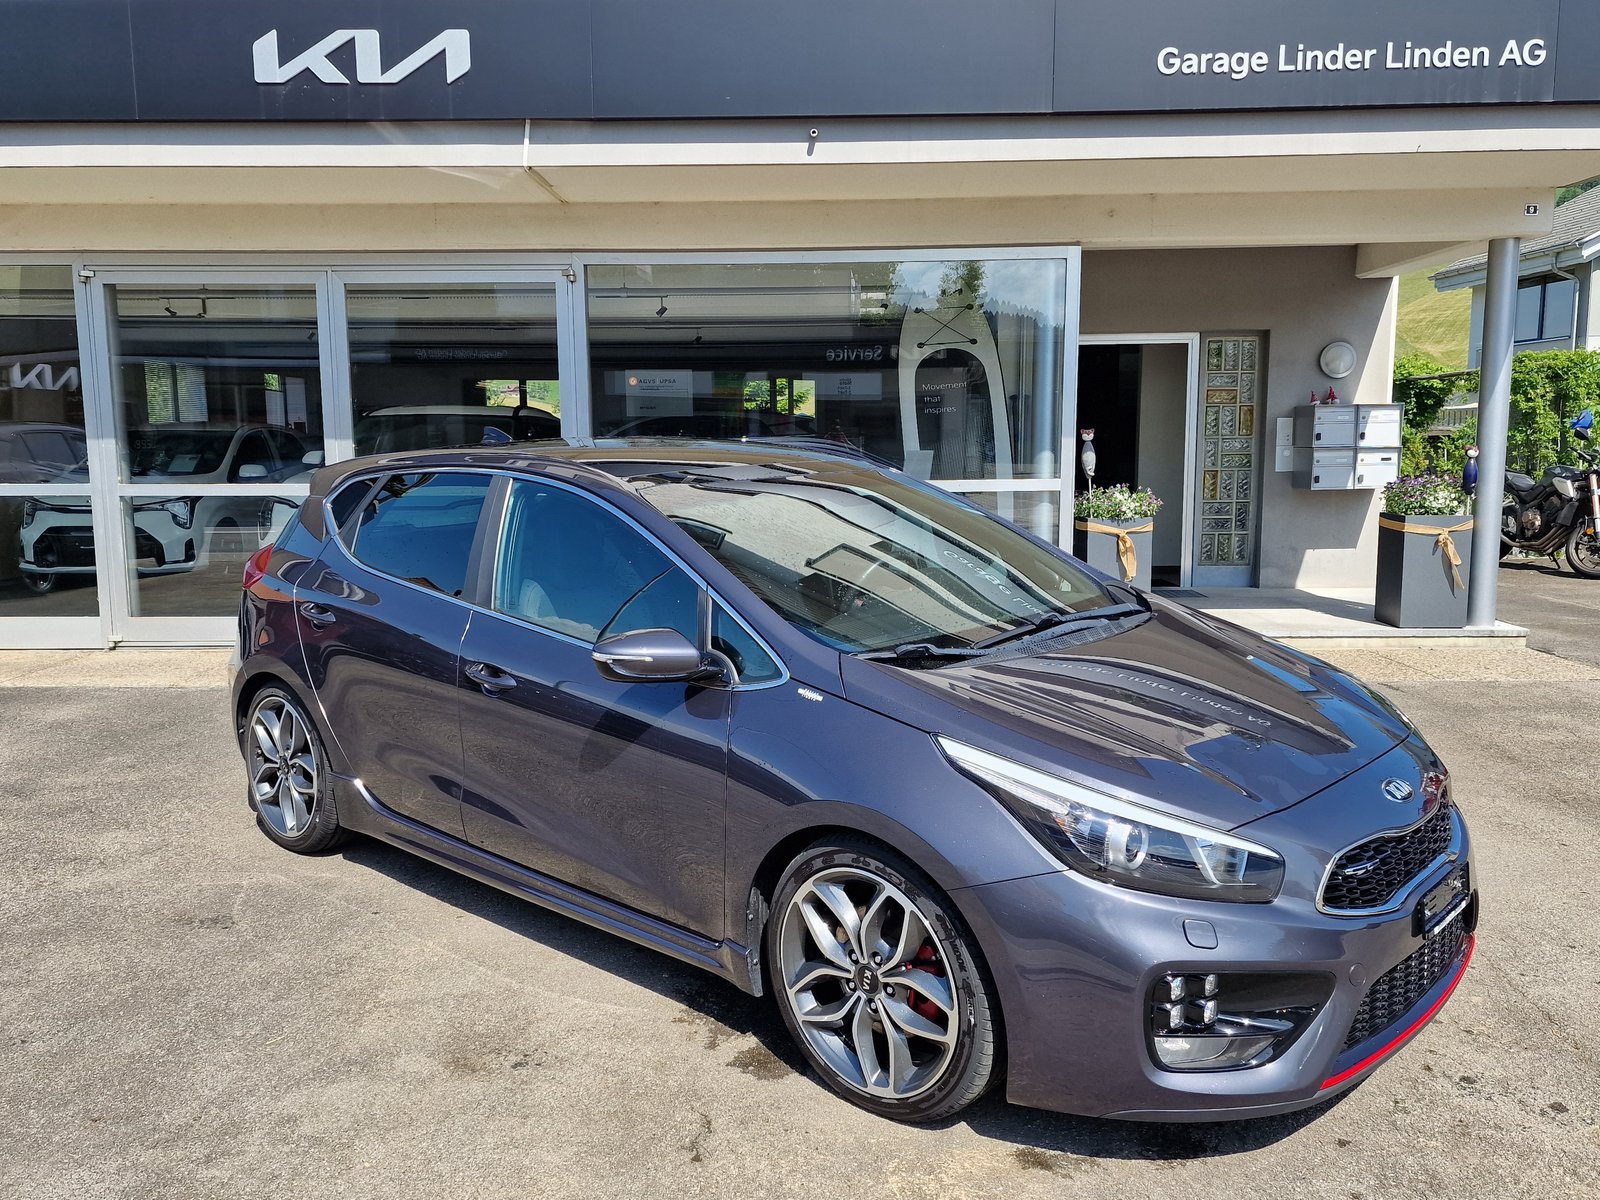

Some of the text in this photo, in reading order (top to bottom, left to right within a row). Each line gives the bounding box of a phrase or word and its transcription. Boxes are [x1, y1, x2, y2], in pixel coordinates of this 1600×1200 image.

[252, 29, 471, 84] KIA
[1156, 38, 1547, 80] Garage Linder Linden AG
[922, 381, 967, 391] Movement
[924, 395, 941, 403] that
[924, 406, 957, 415] inspires
[863, 969, 872, 990] KIA
